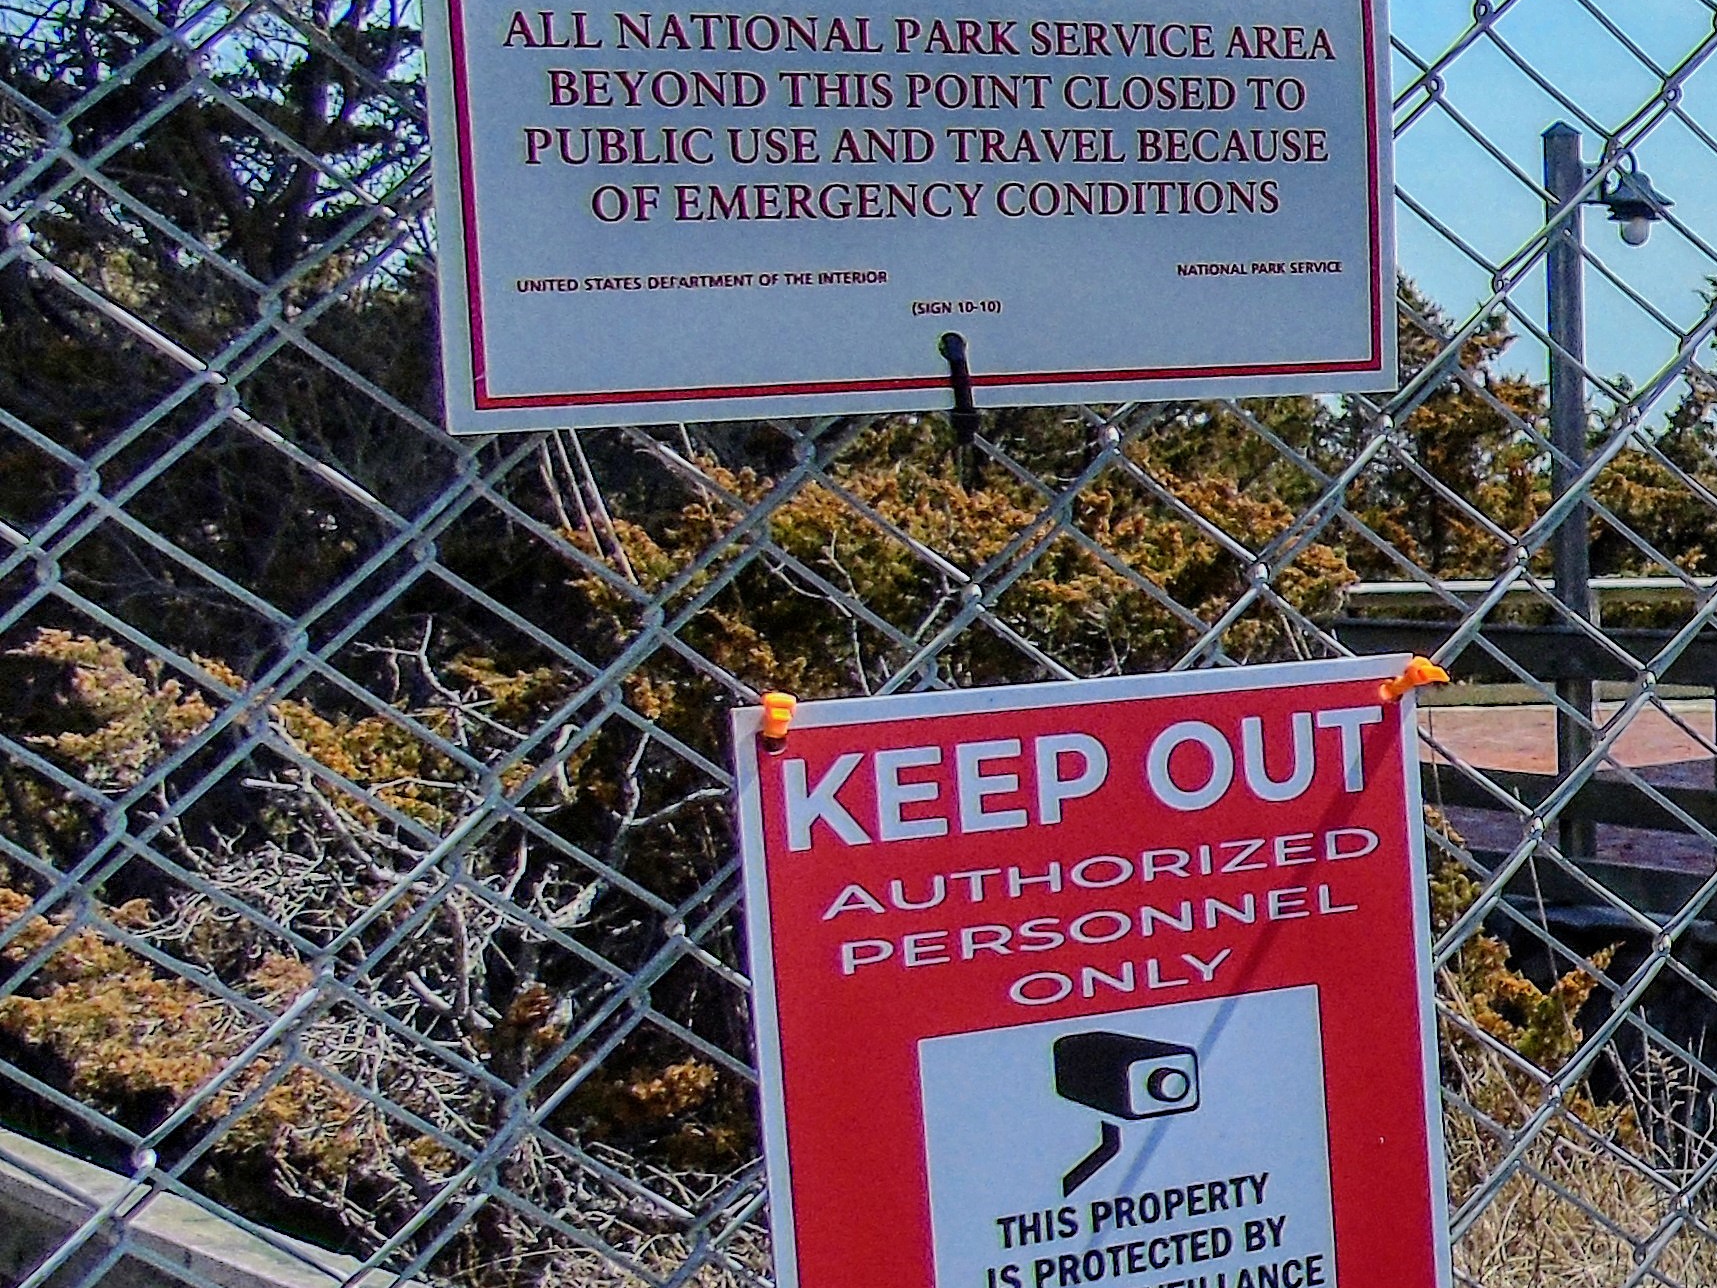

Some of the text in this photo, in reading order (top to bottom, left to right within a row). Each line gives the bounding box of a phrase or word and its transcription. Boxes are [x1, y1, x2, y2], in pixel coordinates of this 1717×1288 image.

[503, 11, 1336, 60] ALL NATIONAL PARK SERVICE AREA
[547, 69, 1306, 111] BEYOND THIS POINT CLOSED TO
[524, 128, 1329, 165] PUBLIC USE AND TRAVEL BECAUSE
[592, 180, 1279, 221] OF EMERGENCY CONDITIONS
[516, 270, 887, 293] UNITED STATES DEPARTMENT OF THE INTERIOR
[1177, 261, 1342, 277] NATIONAL PARK SERVICE
[912, 300, 1001, 317] (SIGN 10-10)
[783, 707, 1383, 853] KEEP OUT
[822, 827, 1380, 921] AUTHORIZED
[841, 884, 1359, 976] PERSONNEL
[1009, 949, 1233, 1007] ONLY
[997, 1173, 1271, 1251] THIS PROPERTY
[1244, 1215, 1287, 1254] BY
